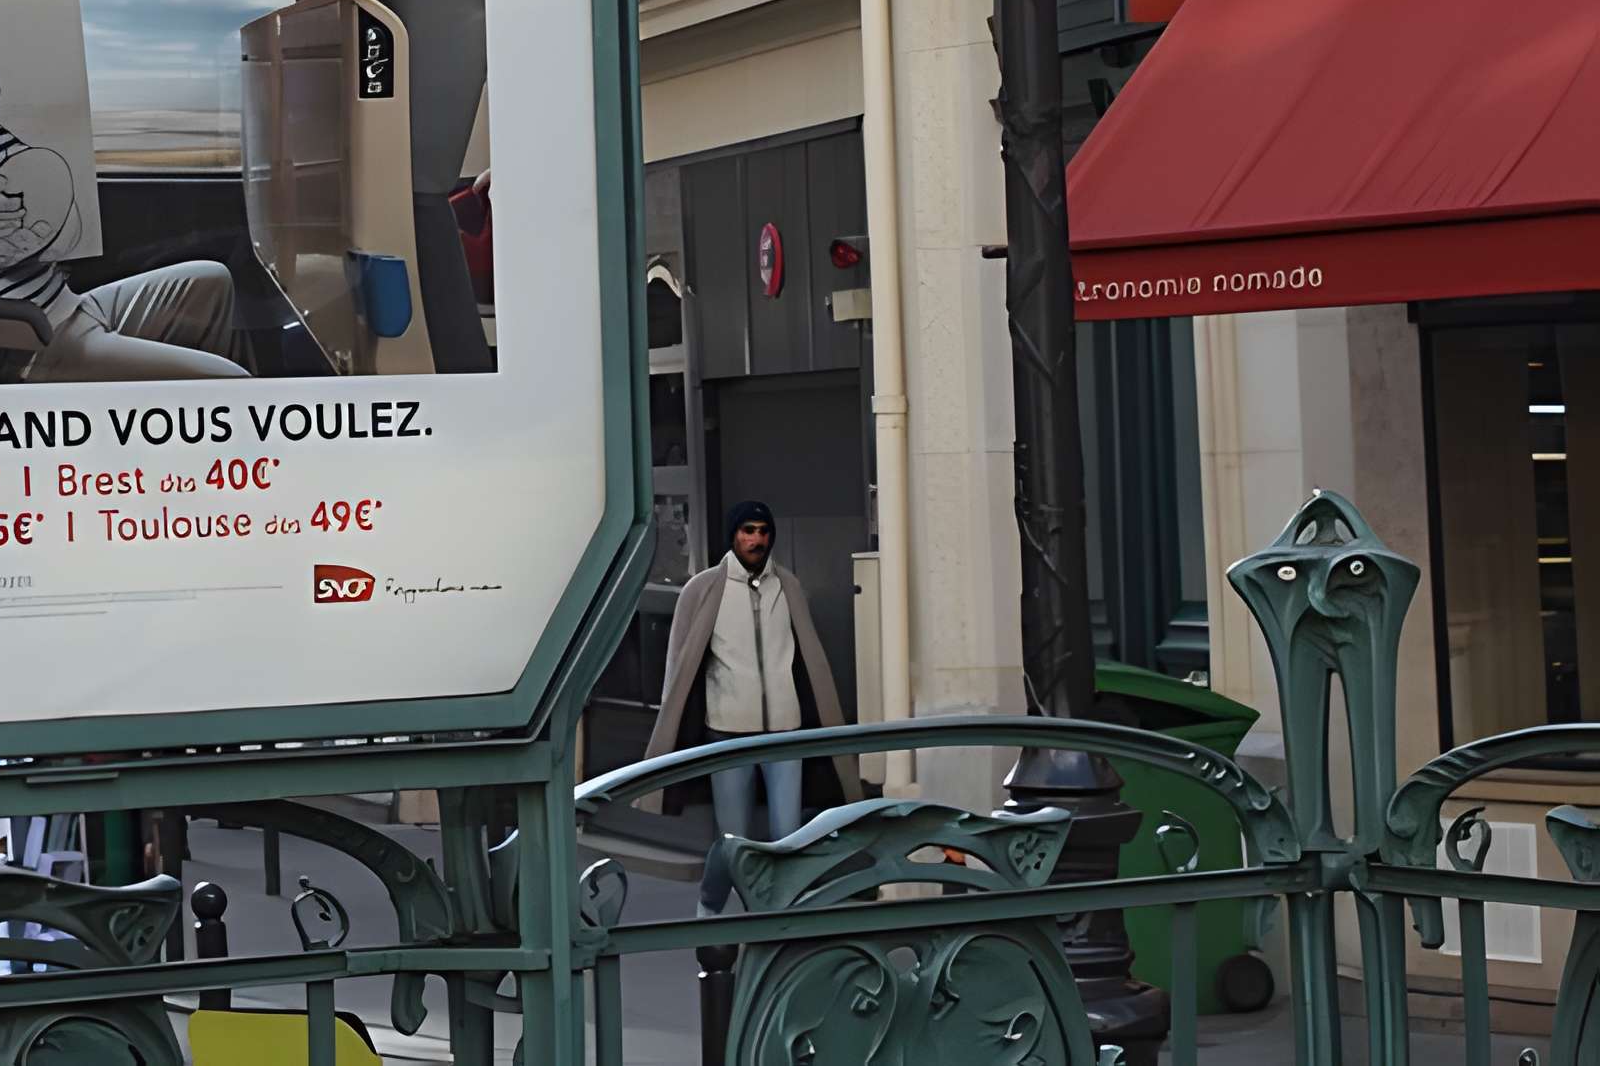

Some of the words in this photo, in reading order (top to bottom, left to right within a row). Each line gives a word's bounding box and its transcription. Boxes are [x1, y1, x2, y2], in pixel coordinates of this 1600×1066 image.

[108, 405, 233, 446] VOUS
[248, 401, 433, 440] VOULEZ.
[57, 464, 146, 496] Brest
[98, 506, 252, 542] Toulouse
